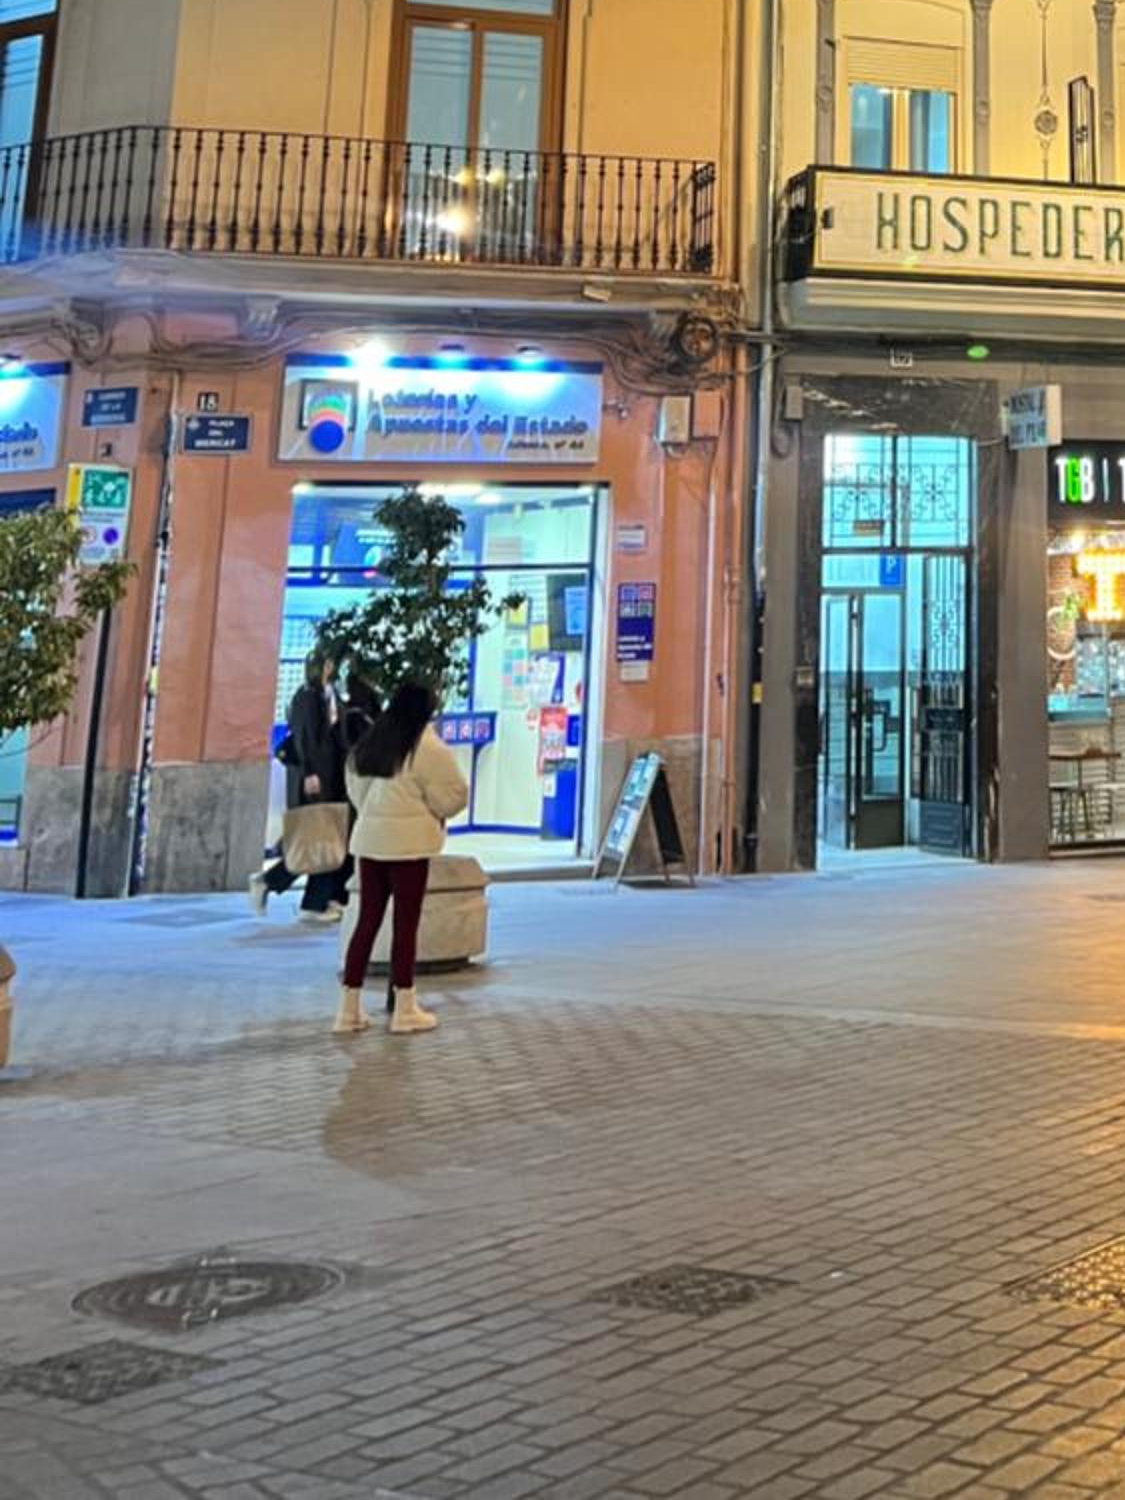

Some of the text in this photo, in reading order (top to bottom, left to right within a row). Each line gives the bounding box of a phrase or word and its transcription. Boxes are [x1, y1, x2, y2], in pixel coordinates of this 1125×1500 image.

[367, 414, 590, 437] Apuestas del Estado
[1056, 454, 1095, 503] TGB
